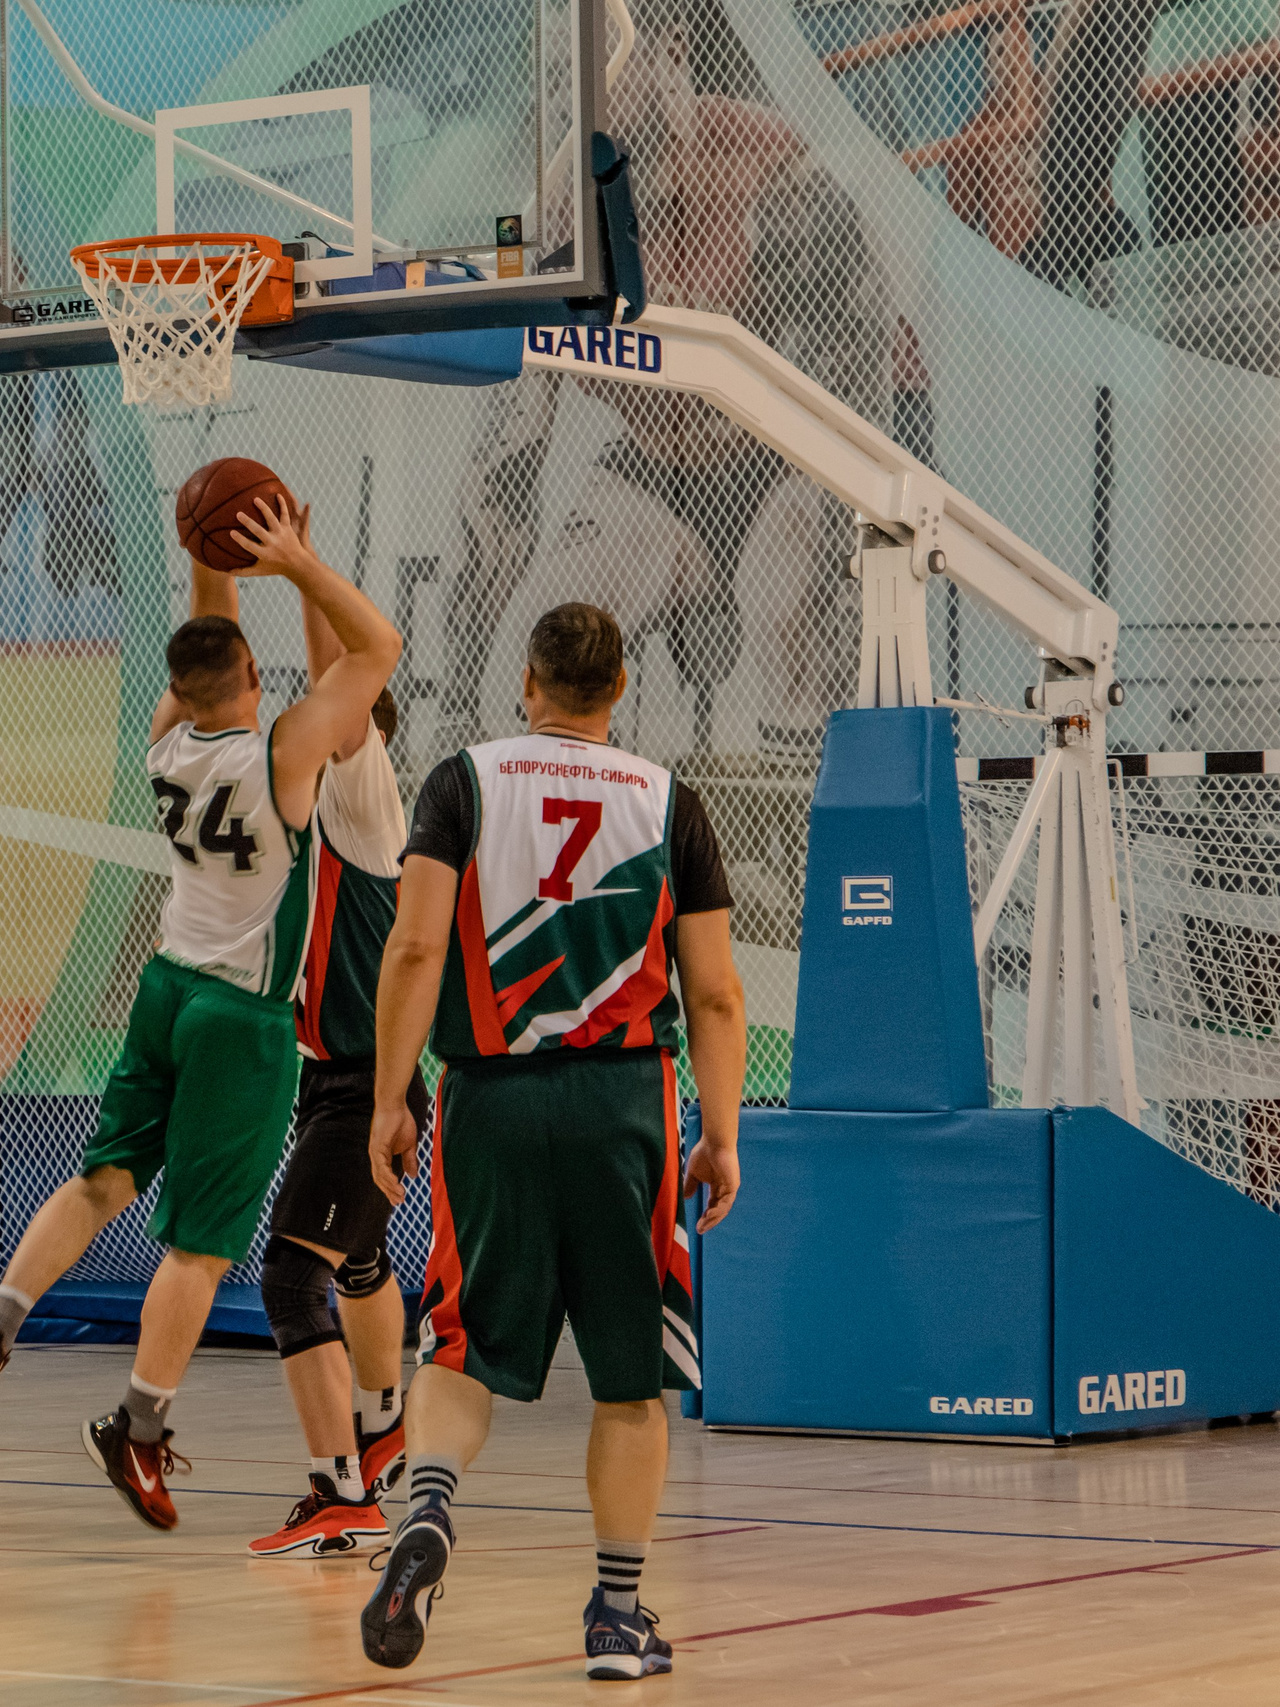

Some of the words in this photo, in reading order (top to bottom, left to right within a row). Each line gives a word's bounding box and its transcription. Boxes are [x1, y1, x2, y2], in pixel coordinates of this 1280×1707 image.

[501, 251, 520, 262] FIBA
[37, 299, 111, 317] GARE
[528, 327, 662, 373] GARED
[499, 760, 648, 789] БЕЛОРУСНЕФТЬ-СИБИРЬ
[150, 775, 260, 873] 24
[539, 797, 603, 902] 7
[930, 1396, 1033, 1416] GARED
[1078, 1369, 1186, 1414] GARED
